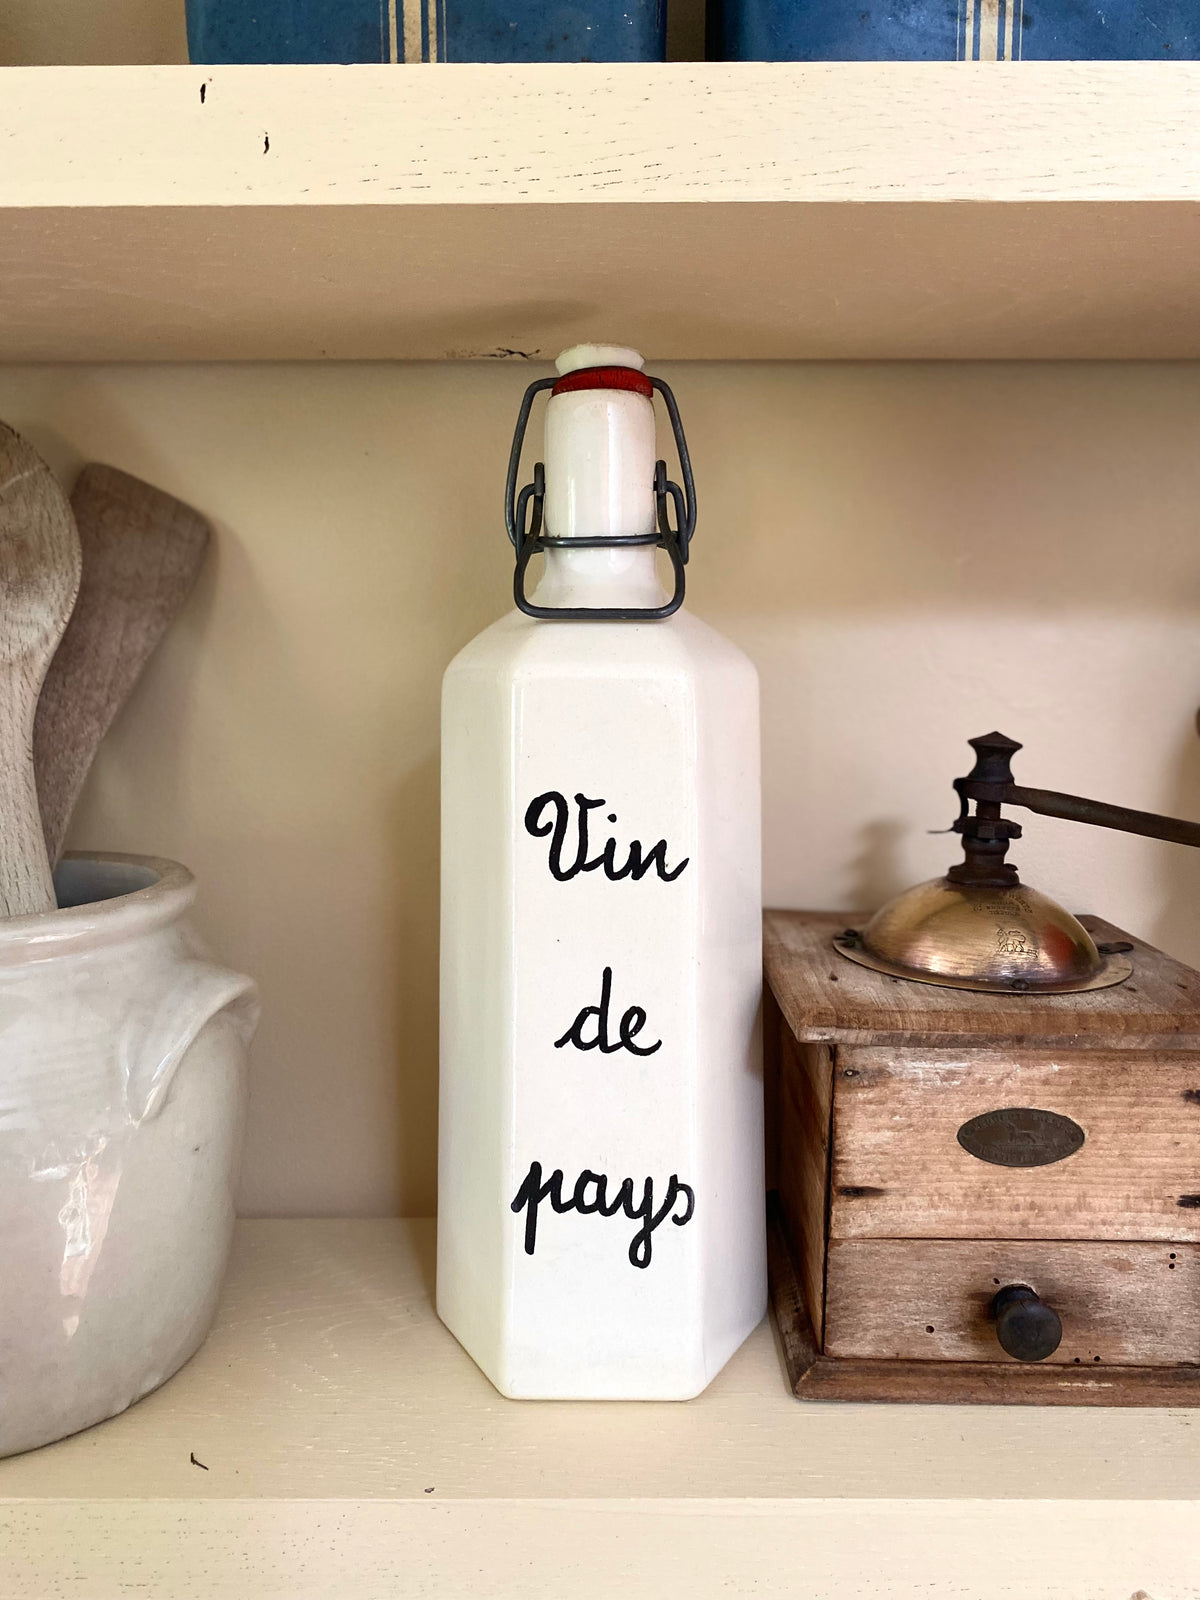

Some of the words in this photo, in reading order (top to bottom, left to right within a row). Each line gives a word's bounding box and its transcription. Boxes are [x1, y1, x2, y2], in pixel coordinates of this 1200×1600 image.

[524, 790, 690, 883] Vin
[553, 966, 663, 1057] de
[510, 1160, 695, 1270] pays
